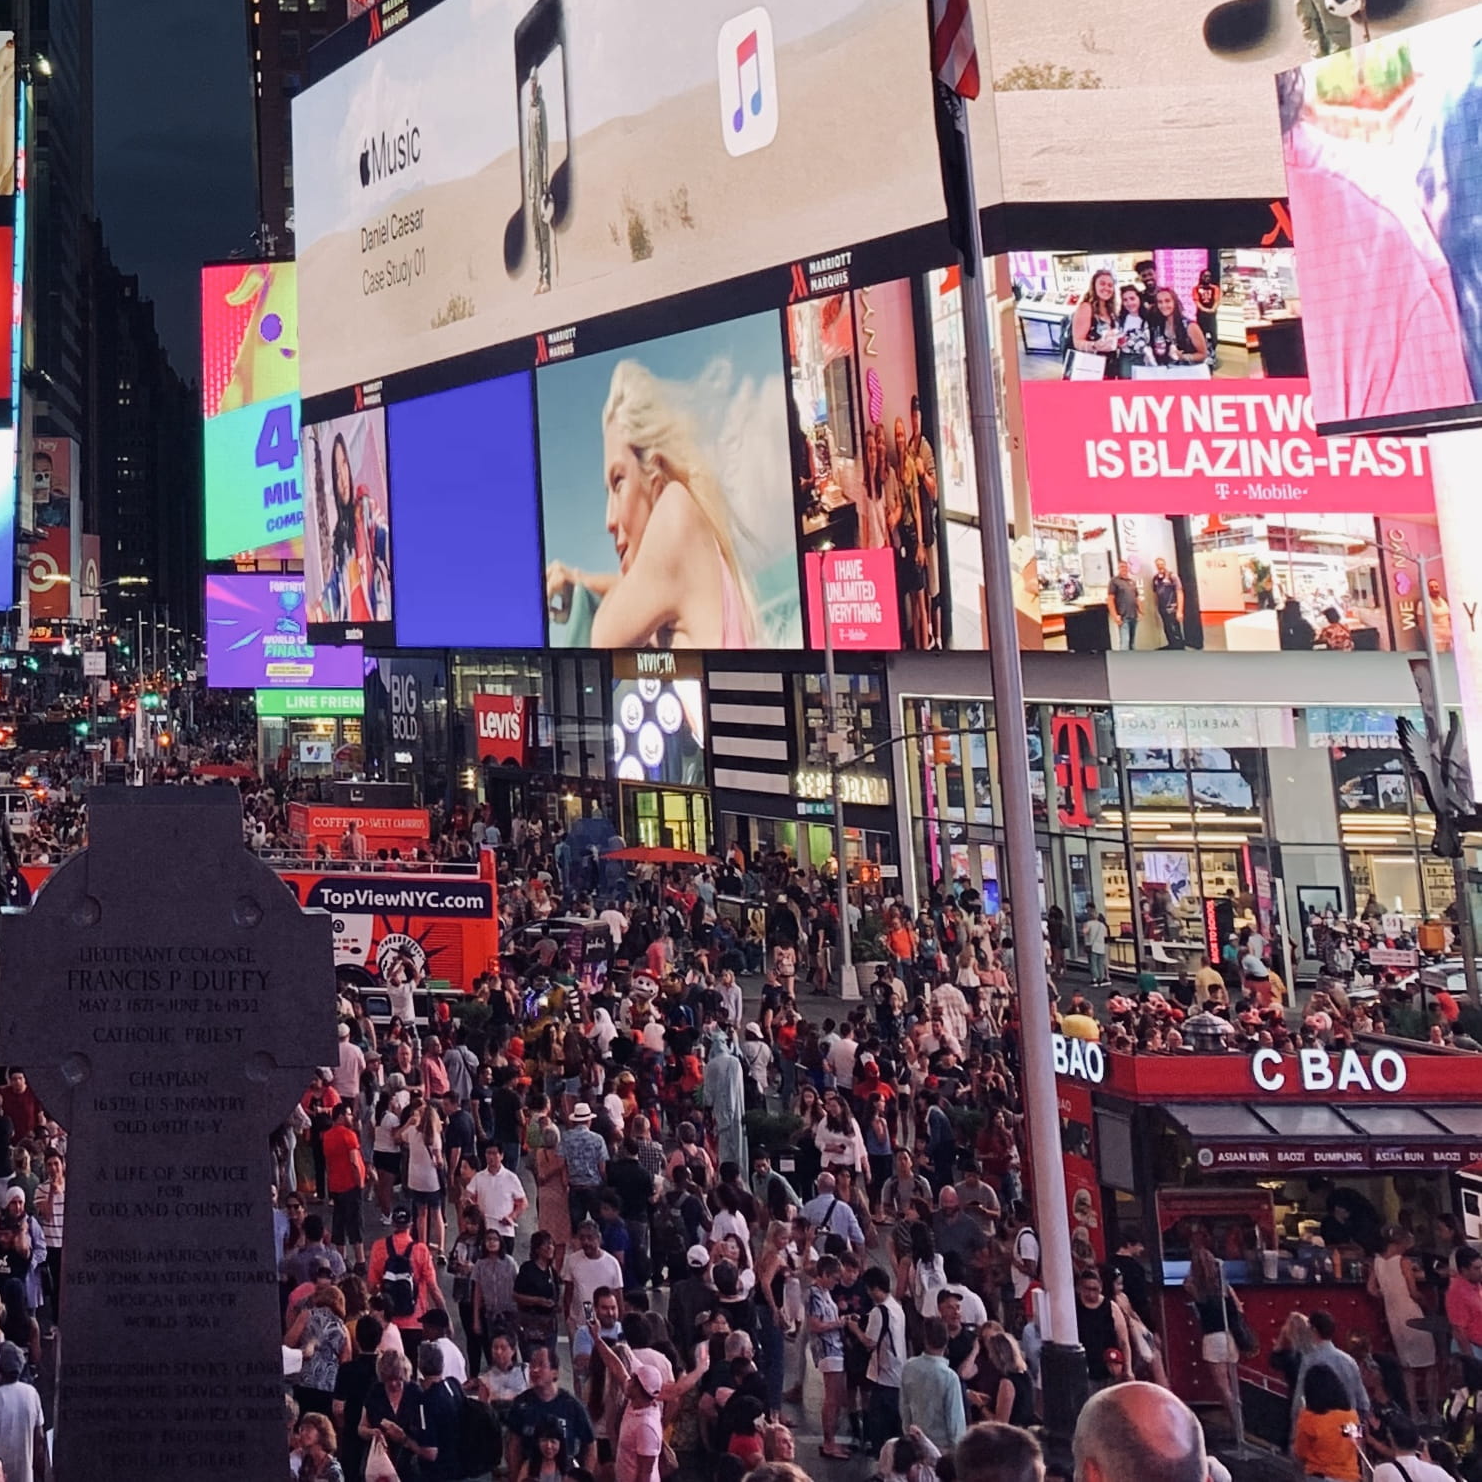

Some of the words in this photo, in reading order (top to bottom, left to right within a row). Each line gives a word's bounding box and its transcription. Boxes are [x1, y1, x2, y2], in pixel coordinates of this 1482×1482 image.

[382, 6, 410, 32] MARQUIS
[371, 118, 422, 184] Music
[361, 210, 389, 253] Daniel
[391, 205, 424, 243] Caesar
[363, 267, 385, 297] Case
[386, 255, 412, 291] Study
[414, 247, 427, 276] 01
[809, 252, 852, 275] MARRIOTT
[810, 270, 850, 293] MARQUIS
[548, 327, 577, 345] MARRIOTT
[548, 341, 575, 359] MARQUIS
[1110, 396, 1175, 434] MY
[1183, 395, 1318, 434] NETWO
[1086, 440, 1125, 479] IS
[1130, 438, 1430, 479] BLAZING-FAST
[838, 559, 864, 580] HAVE
[826, 580, 876, 603] UNLIMITED
[828, 602, 882, 624] VERYTHING
[262, 635, 296, 644] WORLD
[263, 644, 315, 658] FINALS
[637, 652, 677, 674] INVICTA
[286, 696, 318, 708] LINE
[321, 696, 365, 708] FRIEN
[391, 675, 416, 714] BIG
[392, 717, 417, 740] BOLD
[320, 889, 484, 909] TopViewNYC.com
[79, 947, 173, 963] LIEUTENANT
[178, 947, 256, 963] COLONEL
[68, 970, 161, 991] FRANCIS
[192, 970, 271, 991] DUFFY
[78, 999, 109, 1013] MAY
[93, 1028, 176, 1044] CATHOLIC
[185, 1028, 246, 1044] PRIEST
[1051, 1032, 1104, 1084] BAO
[129, 1071, 210, 1087] CHAPLAIN
[1252, 1049, 1285, 1092] C
[1300, 1048, 1407, 1093] BAO
[93, 1097, 137, 1112] 165TH
[175, 1097, 246, 1112] INFANTRY
[114, 1120, 148, 1134] OLD
[1218, 1150, 1247, 1163] ASIAN
[1249, 1150, 1270, 1163] BUN
[1277, 1150, 1306, 1163] BAOZI
[1313, 1150, 1364, 1163] DUMPLING
[1375, 1150, 1403, 1163] ASIAN
[1404, 1150, 1425, 1163] BUN
[1432, 1150, 1462, 1163] BAOZI
[96, 1167, 108, 1182] A
[115, 1167, 147, 1182] LIFE
[154, 1167, 174, 1182] OF
[182, 1166, 249, 1182] SERVICE
[157, 1185, 185, 1199] FOR
[88, 1202, 129, 1217] GOD
[132, 1202, 169, 1217] AND
[175, 1202, 254, 1218] COUNTRY
[226, 1249, 259, 1263] WAR
[148, 1271, 219, 1285] NATIONAL
[225, 1270, 278, 1285] GUARD
